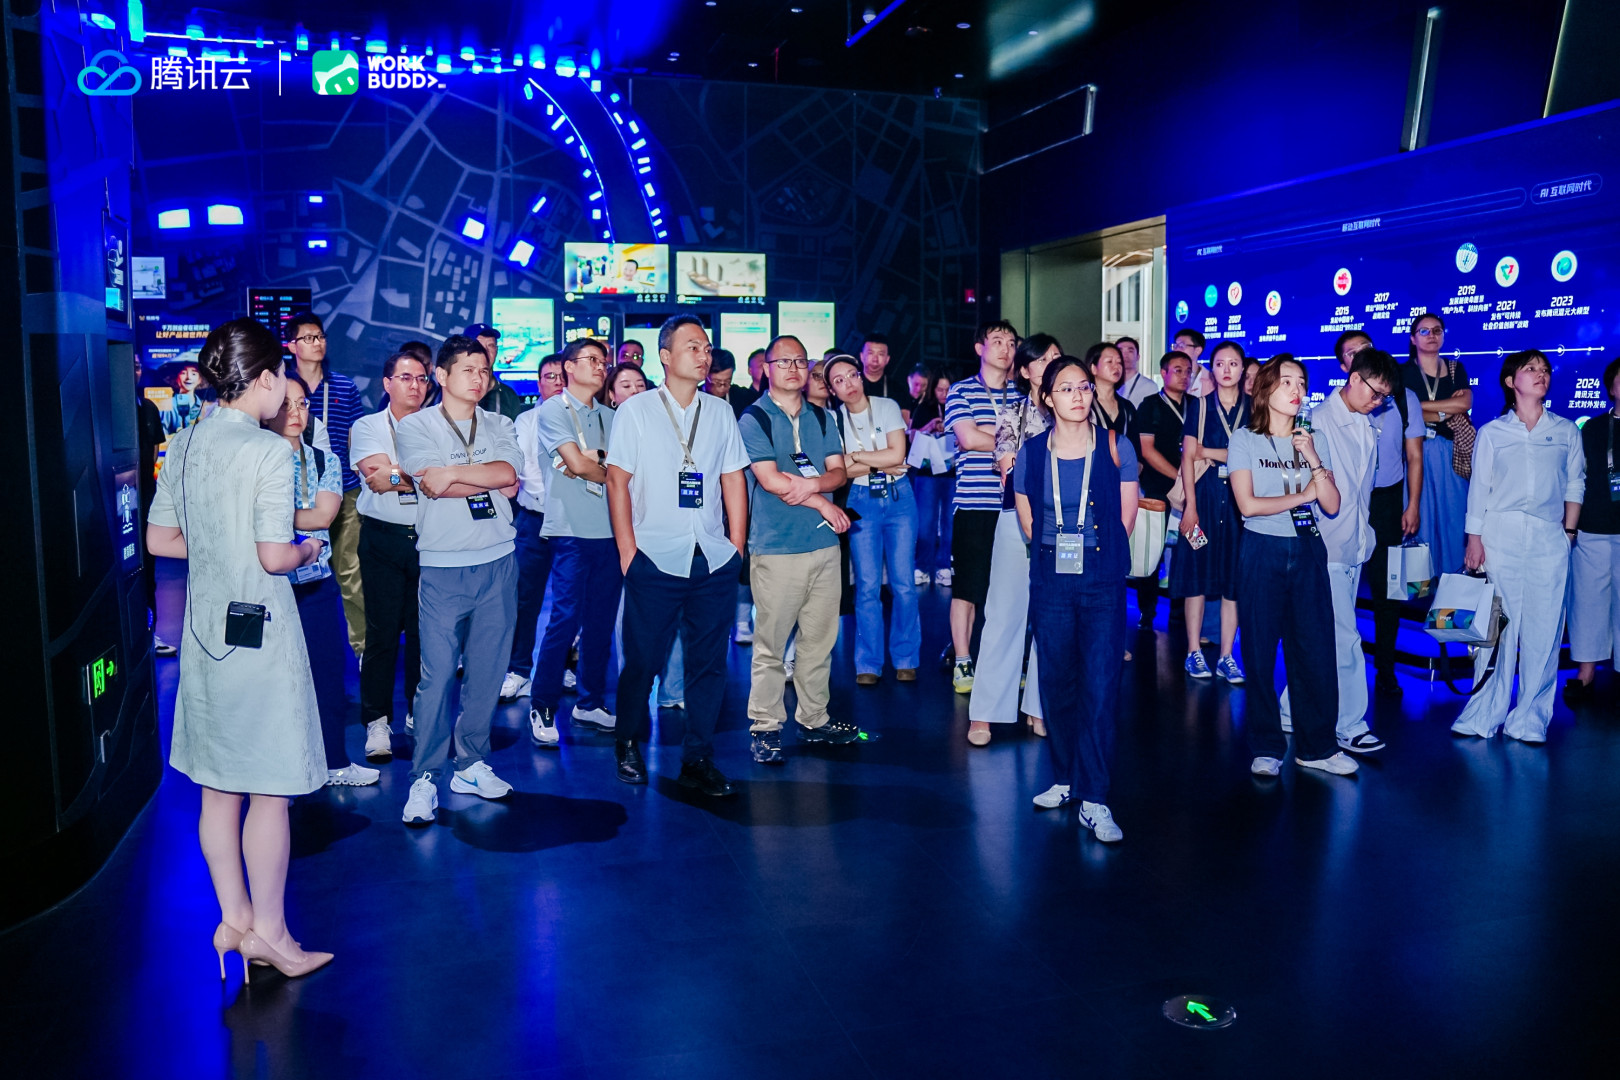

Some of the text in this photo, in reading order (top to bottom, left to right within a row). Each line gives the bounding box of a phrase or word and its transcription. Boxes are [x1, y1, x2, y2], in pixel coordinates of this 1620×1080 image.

[1540, 180, 1592, 198] AI 互联网时代
[1457, 285, 1476, 295] 2019
[1374, 292, 1390, 302] 2017
[1550, 296, 1573, 307] 2023
[1496, 300, 1516, 311] 2021
[1335, 306, 1350, 316] 2015
[1576, 378, 1600, 388] 2024
[1574, 390, 1600, 399] 腾讯元宝
[1568, 400, 1606, 408] 正式对外发布
[1259, 458, 1281, 468] Mon
